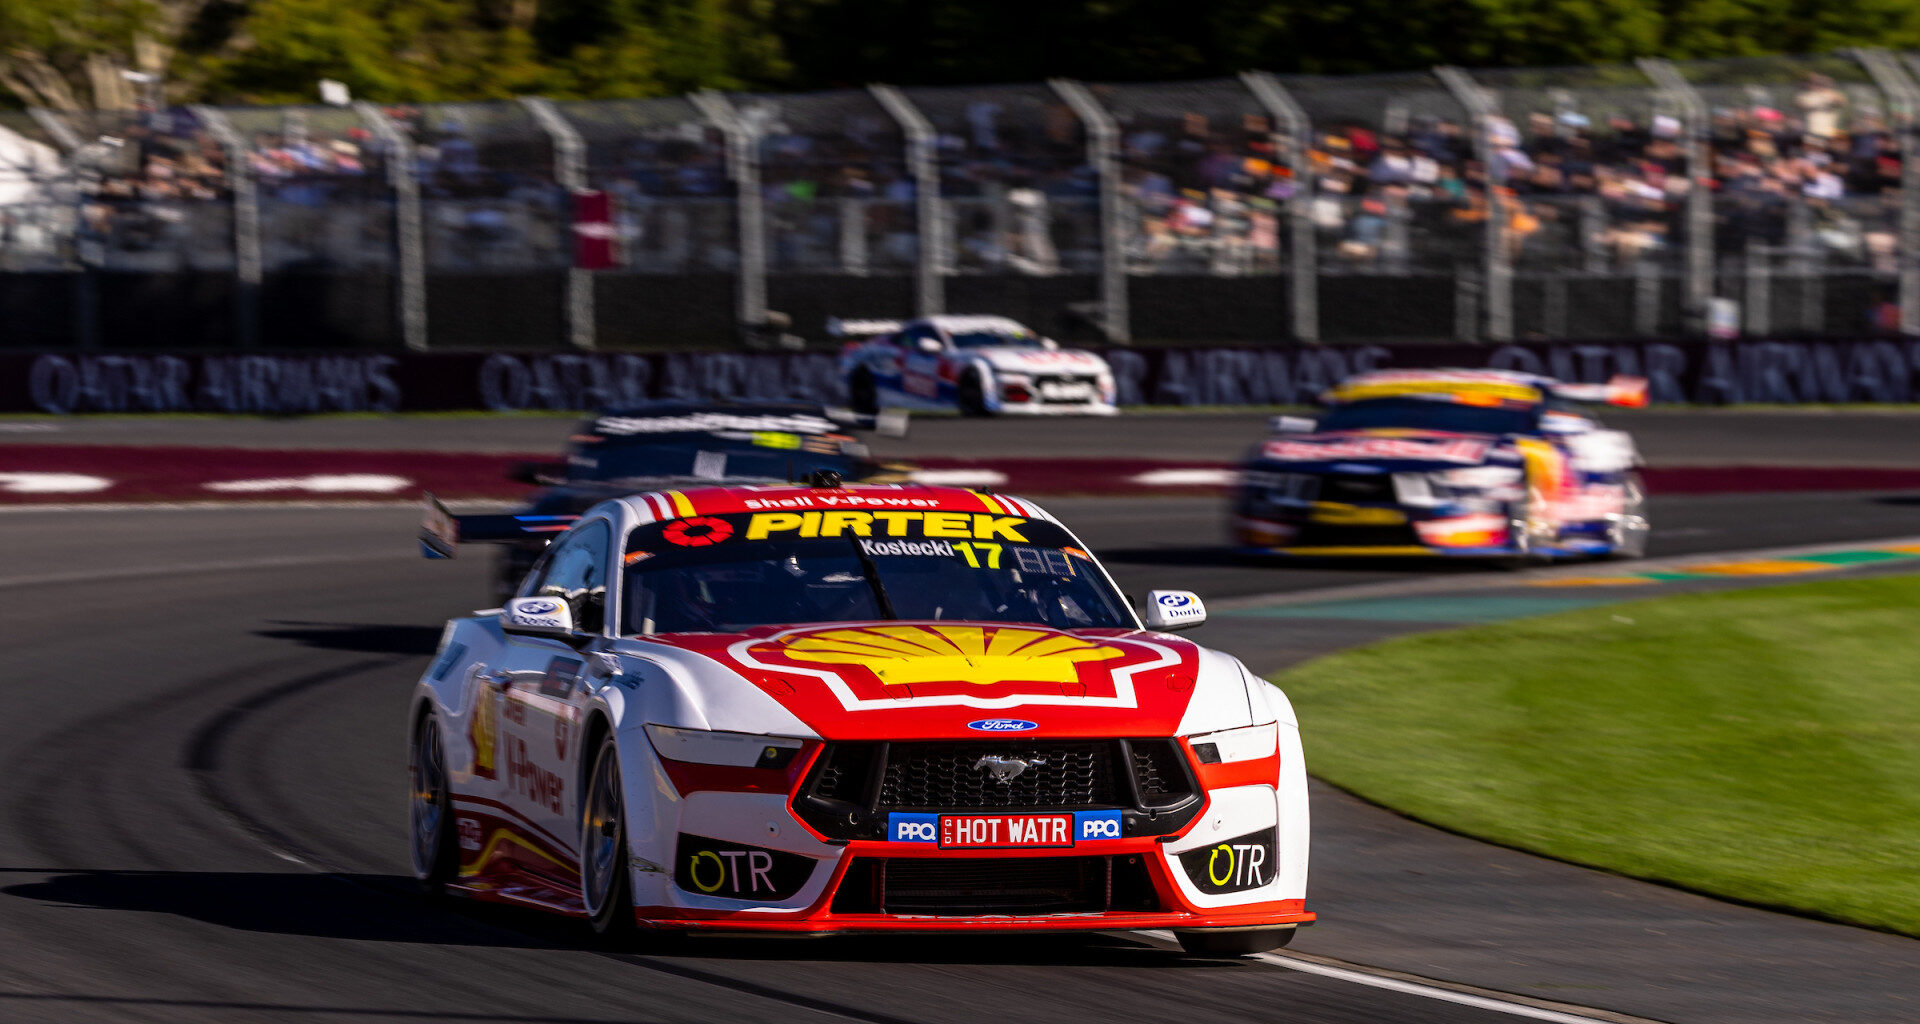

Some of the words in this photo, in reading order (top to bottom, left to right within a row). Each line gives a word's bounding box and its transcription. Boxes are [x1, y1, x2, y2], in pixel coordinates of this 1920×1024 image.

[29, 355, 190, 413] QATAR
[198, 355, 400, 412] AIRWAYS
[479, 354, 650, 411] QATAR
[1695, 341, 1920, 403] AIRWAY
[745, 496, 813, 509] Shell
[818, 496, 940, 507] V-Power
[745, 511, 1030, 543] PIRTEK
[860, 538, 955, 558] Kostecki
[952, 541, 1003, 569] 17
[982, 720, 1024, 730] Ford
[898, 822, 936, 840] PPQ
[956, 818, 1001, 843] HOT
[1008, 818, 1067, 843] WATR
[1083, 819, 1119, 838] PPQ
[691, 850, 776, 892] OTR
[1209, 844, 1265, 886] OTR
